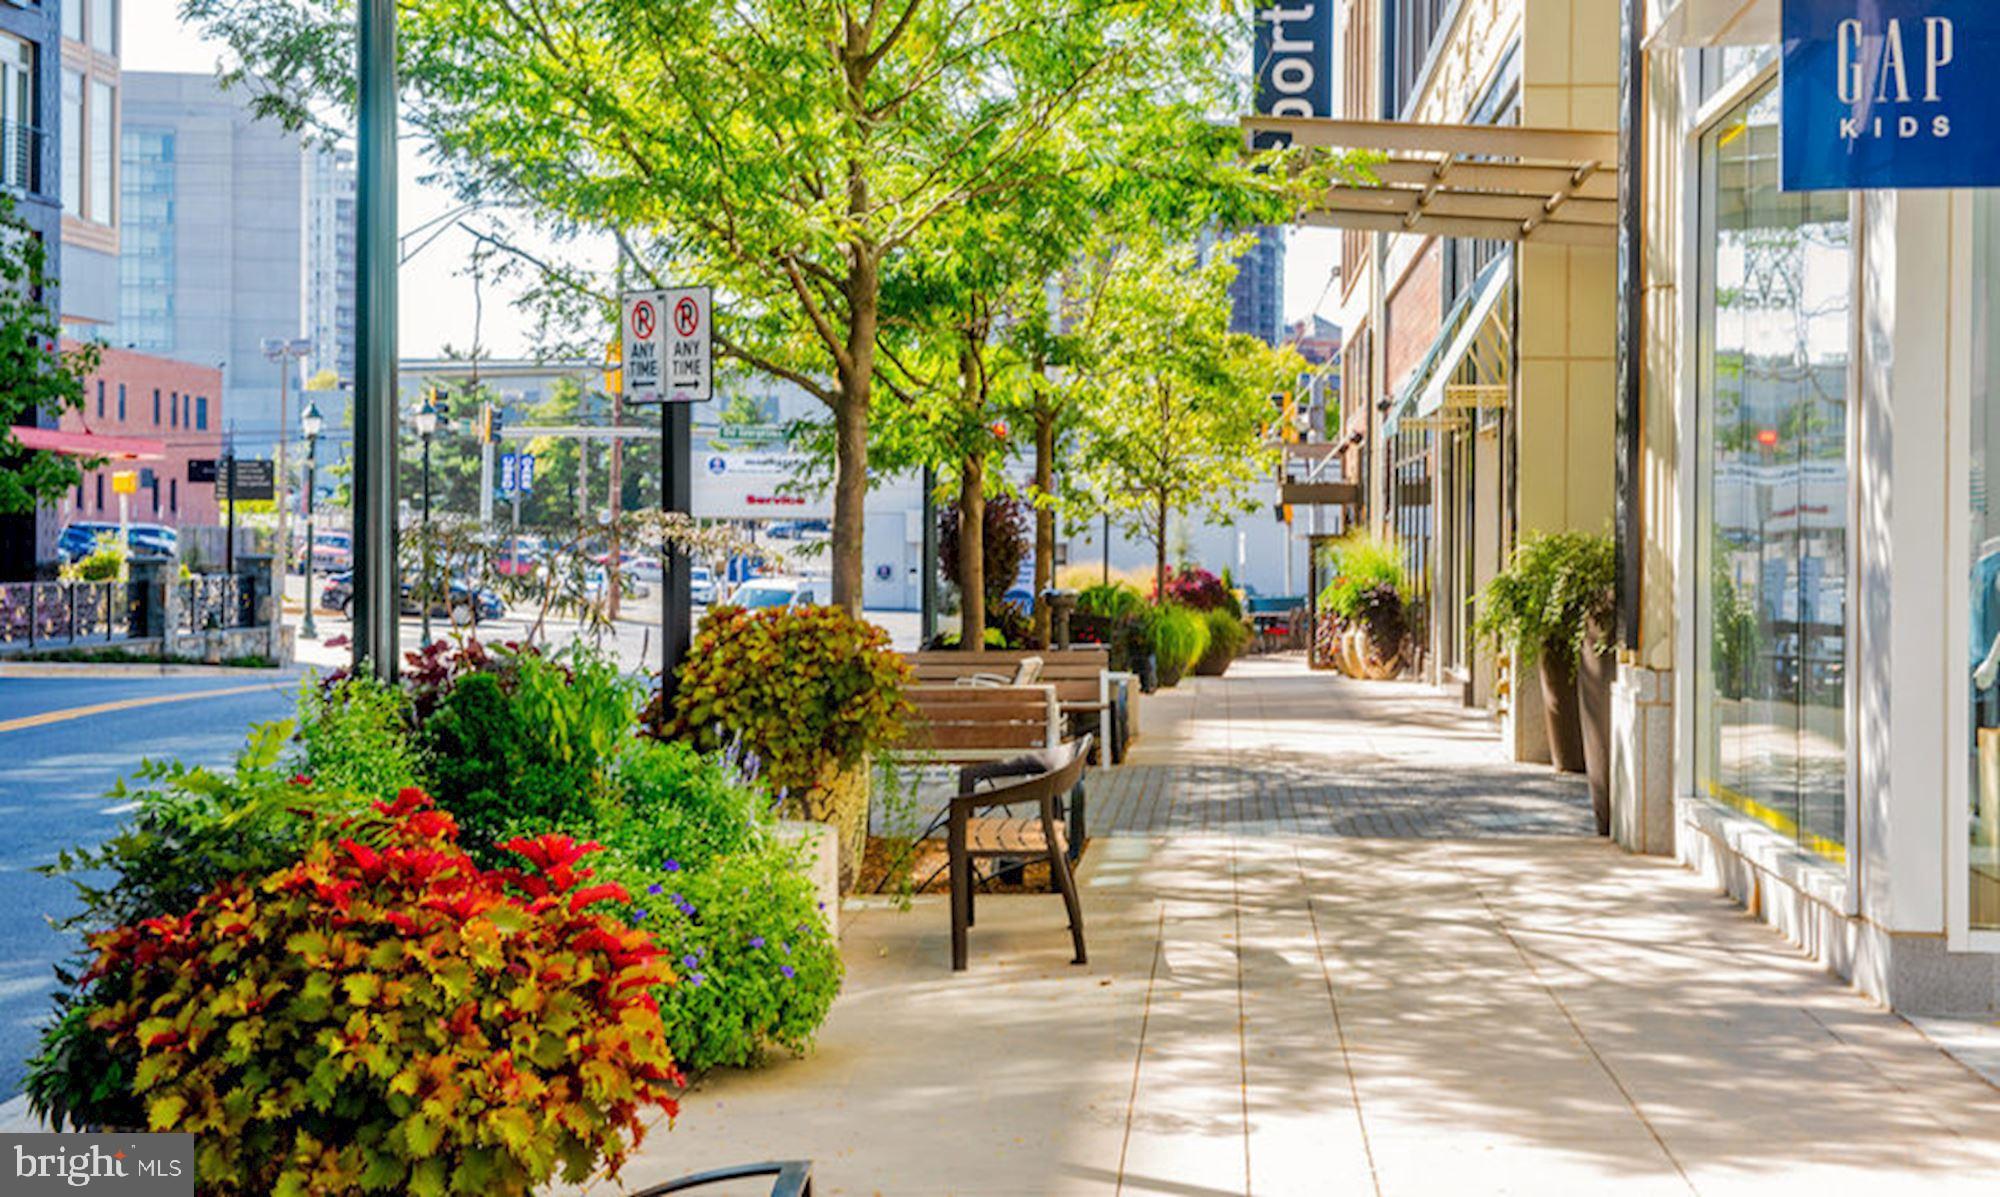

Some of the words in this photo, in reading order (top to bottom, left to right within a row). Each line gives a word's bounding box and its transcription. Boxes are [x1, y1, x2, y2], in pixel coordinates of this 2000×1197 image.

[1836, 16, 1954, 104] GAP
[1839, 115, 1951, 139] KIDS
[631, 342, 656, 357] ANY
[674, 341, 700, 356] ANY
[630, 360, 658, 376] TIME
[674, 360, 701, 375] TIME
